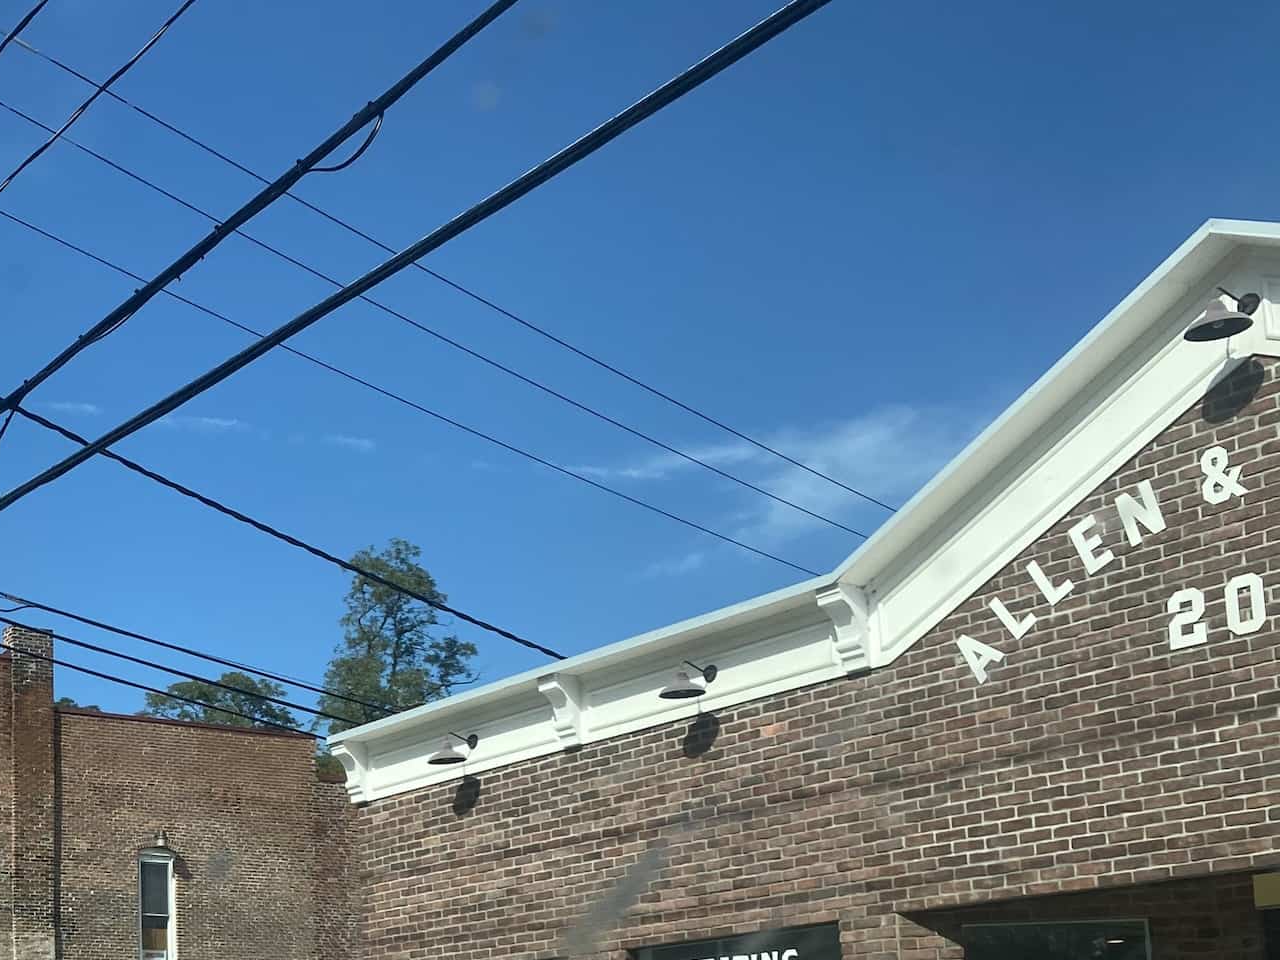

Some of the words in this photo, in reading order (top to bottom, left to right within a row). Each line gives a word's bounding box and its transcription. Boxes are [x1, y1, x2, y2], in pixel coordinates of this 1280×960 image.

[956, 479, 1167, 685] ALLEN
[1200, 445, 1249, 505] &
[1167, 572, 1266, 651] 20
